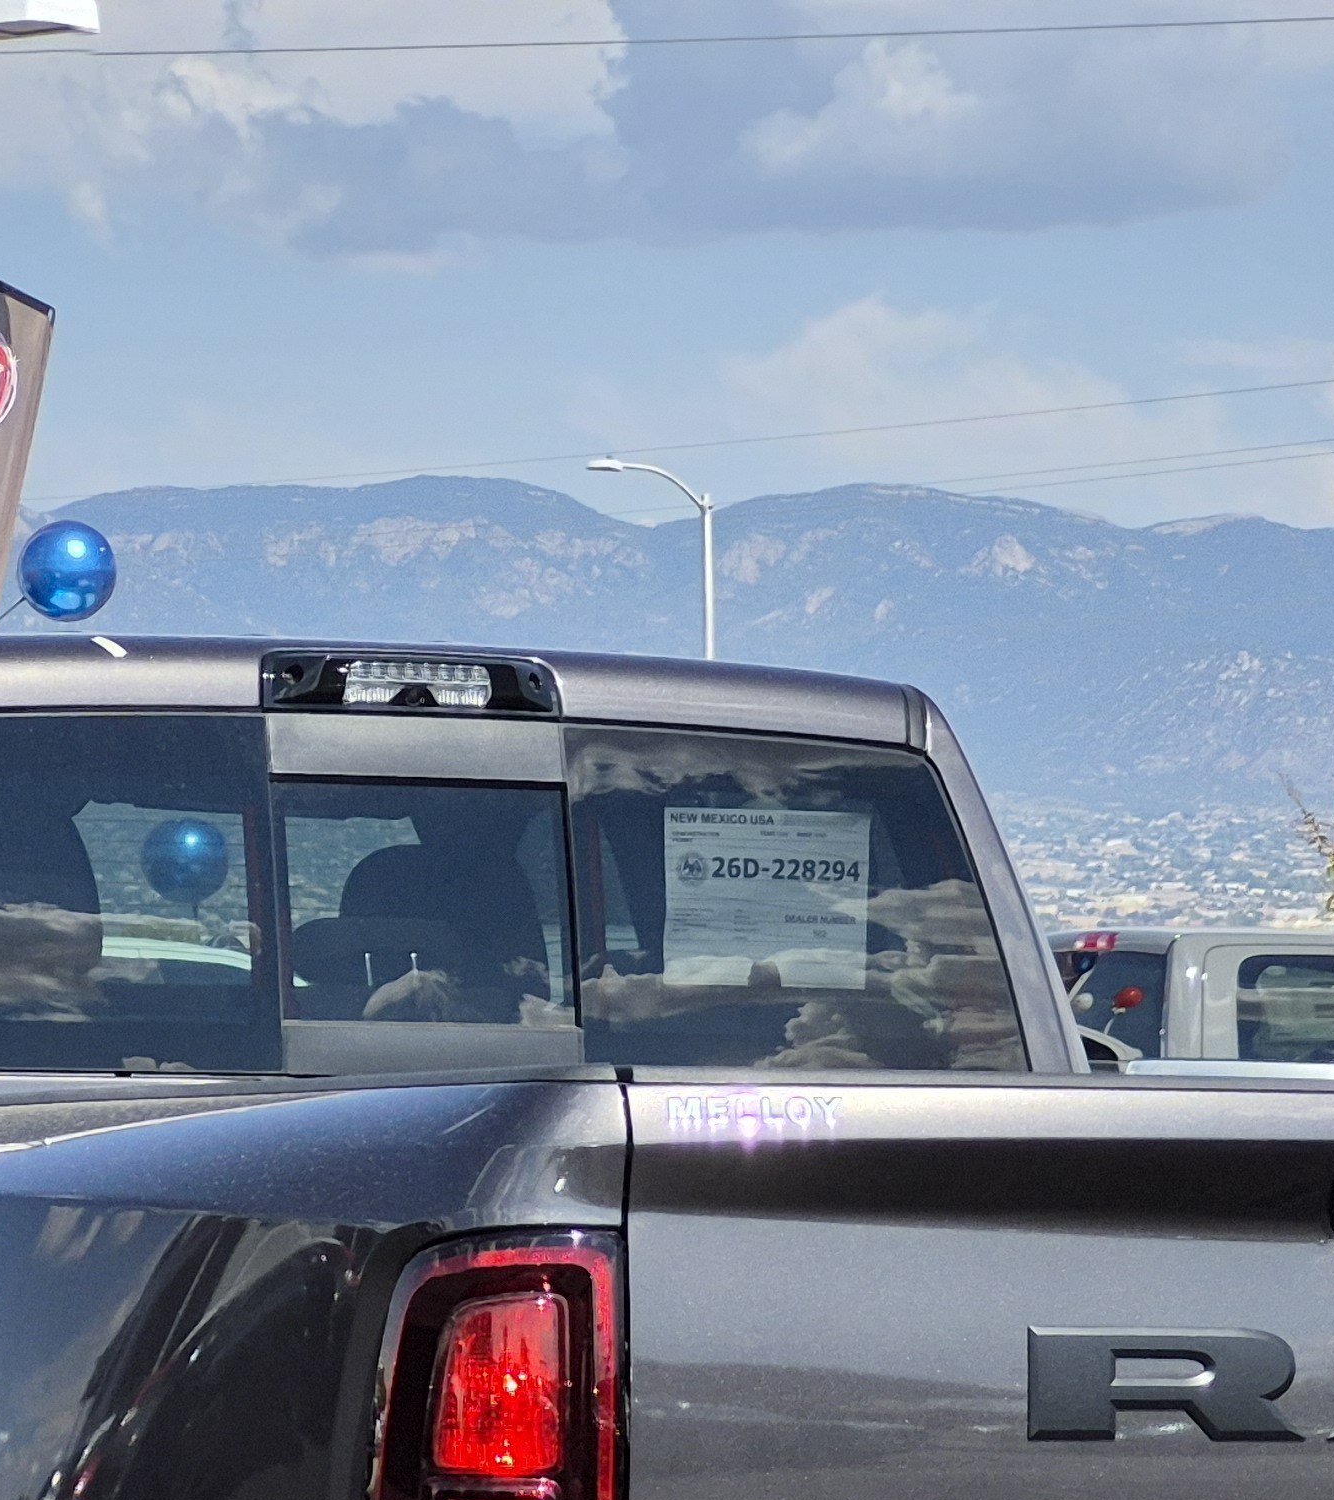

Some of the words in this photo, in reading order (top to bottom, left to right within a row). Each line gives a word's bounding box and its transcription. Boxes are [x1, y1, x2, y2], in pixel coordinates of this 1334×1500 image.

[670, 812, 698, 824] NEW
[701, 813, 747, 825] MEXICO
[750, 814, 775, 826] USA
[711, 856, 861, 882] 26D-228294
